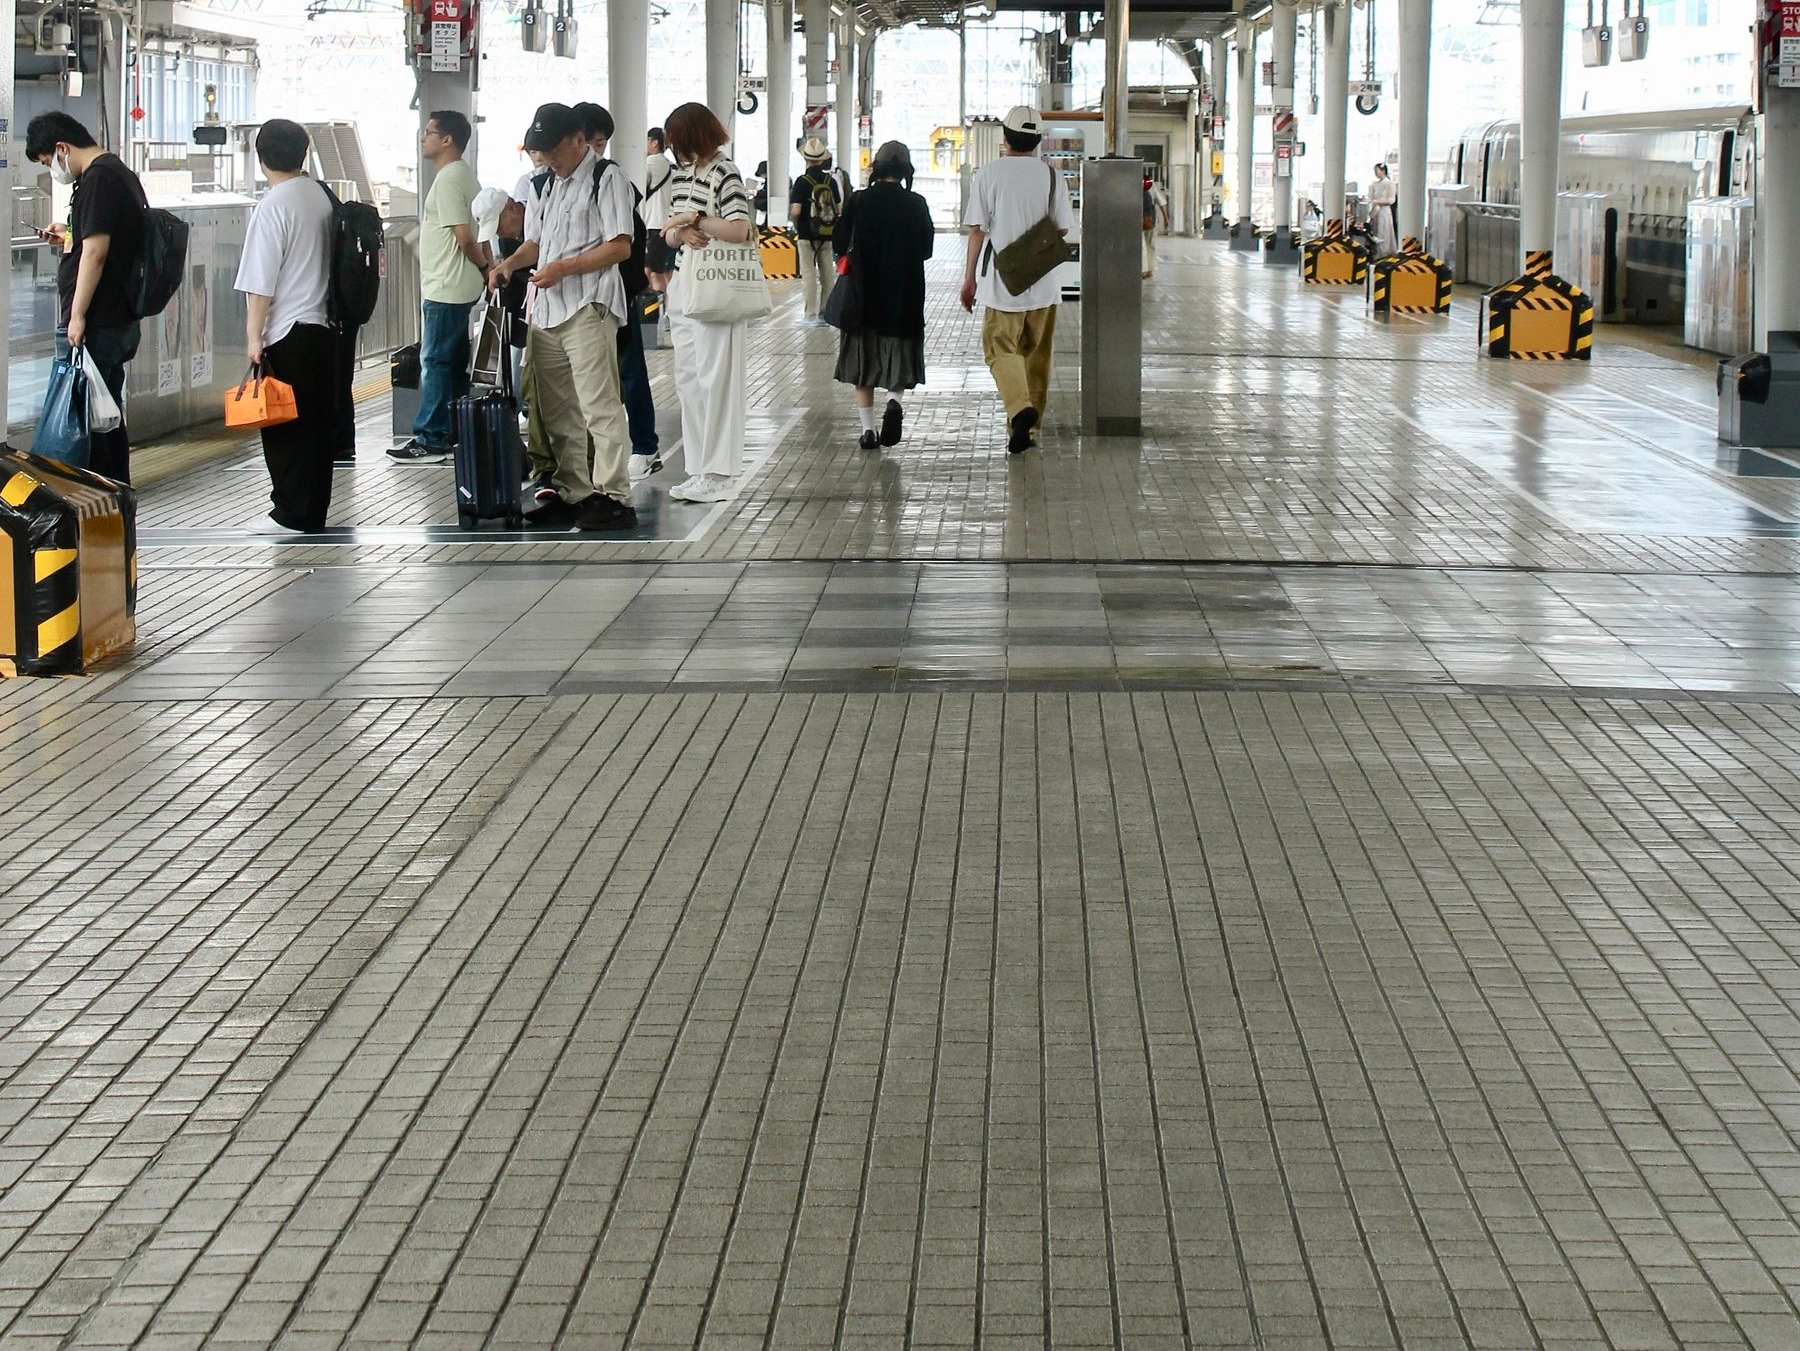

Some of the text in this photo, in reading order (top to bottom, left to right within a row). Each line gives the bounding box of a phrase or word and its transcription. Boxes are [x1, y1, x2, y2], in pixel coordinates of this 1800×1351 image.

[1782, 6, 1800, 15] STO
[526, 14, 534, 25] 3
[556, 22, 564, 31] 2
[1636, 22, 1645, 32] 3
[1601, 31, 1609, 40] 2
[703, 249, 758, 262] PORTE
